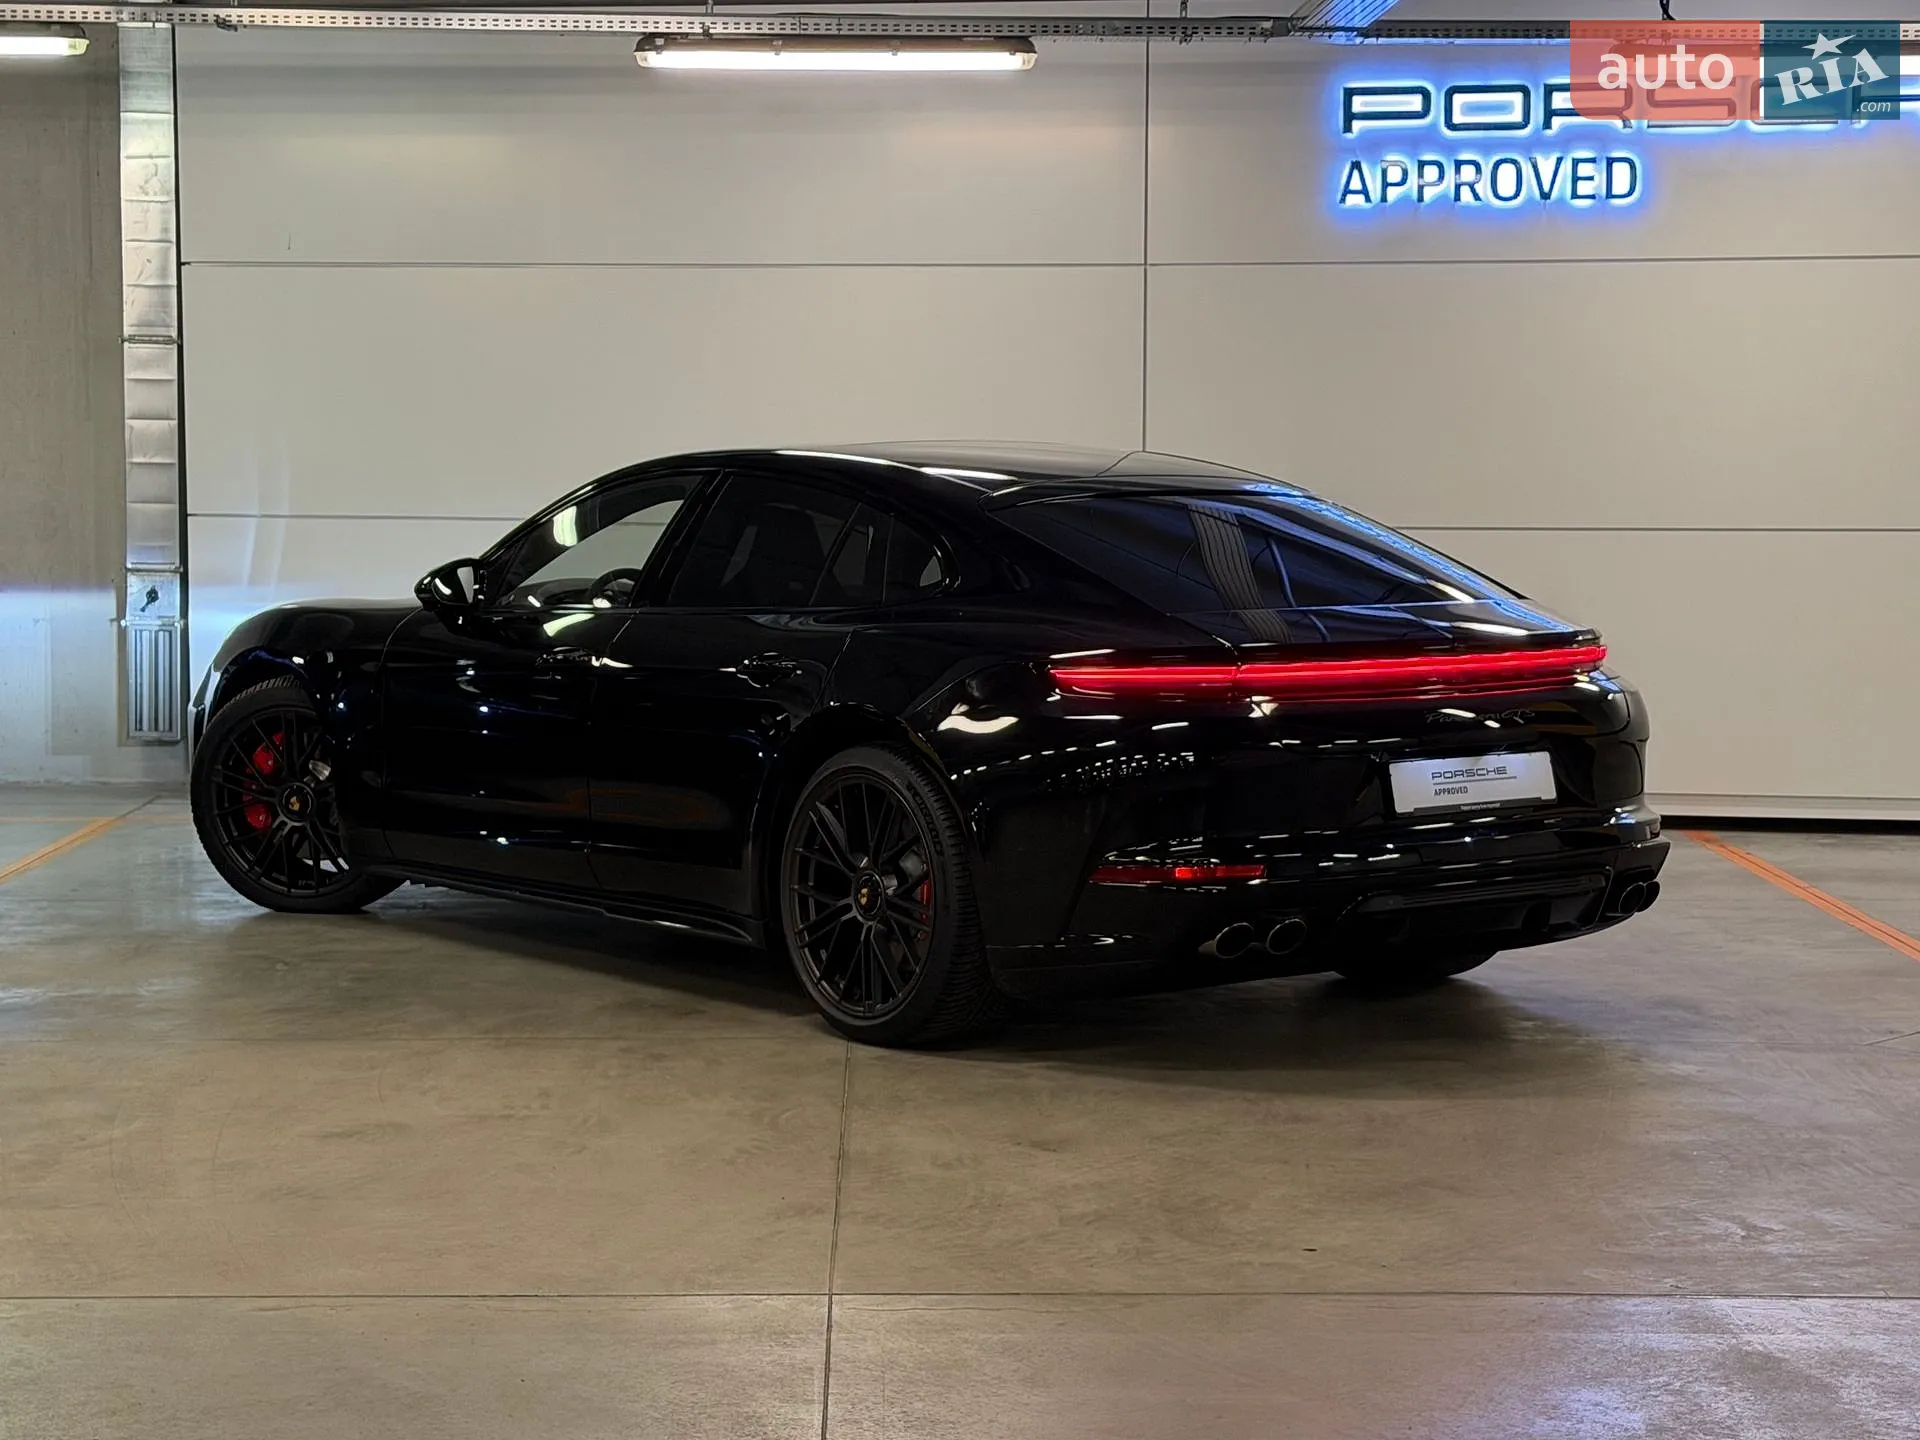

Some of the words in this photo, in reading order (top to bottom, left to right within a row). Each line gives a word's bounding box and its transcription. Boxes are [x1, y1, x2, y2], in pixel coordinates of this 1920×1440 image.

[1338, 157, 1638, 204] APPROVED
[1431, 766, 1508, 780] PORSCHE
[1434, 785, 1469, 796] APPROVED
